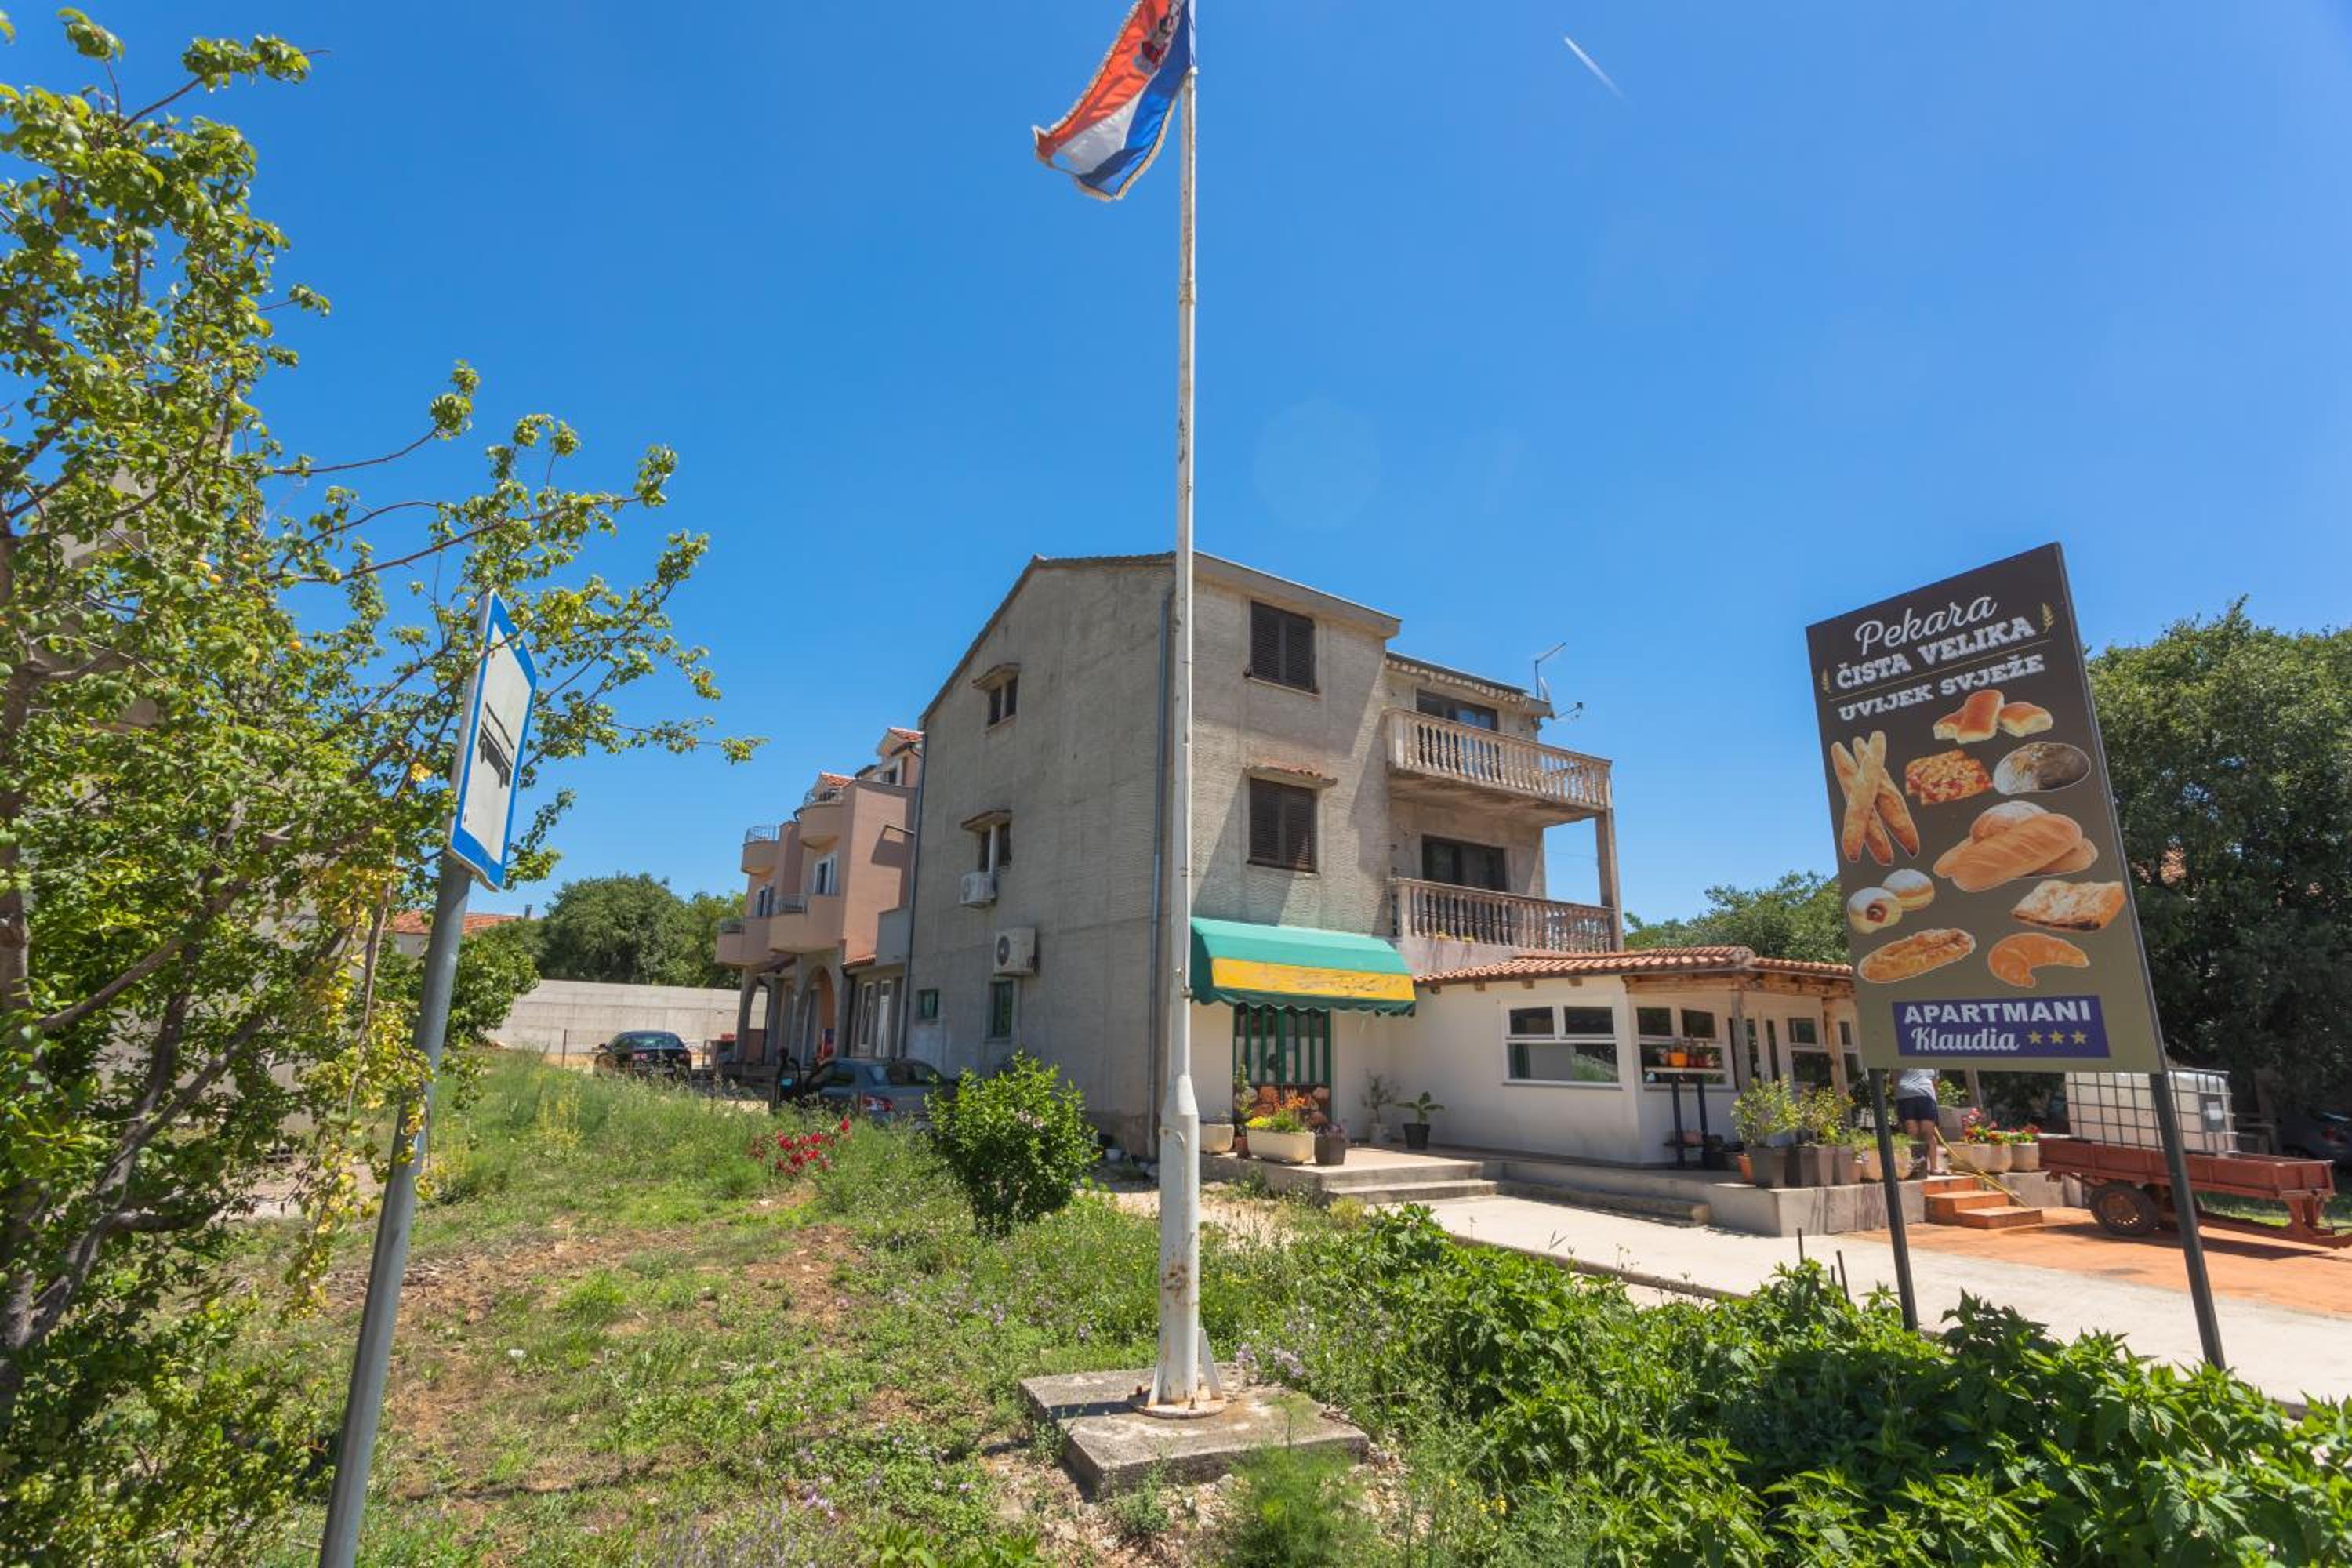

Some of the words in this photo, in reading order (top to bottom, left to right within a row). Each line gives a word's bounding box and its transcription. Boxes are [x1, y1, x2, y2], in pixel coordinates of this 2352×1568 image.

[1837, 653, 1911, 689] ČISTA
[1918, 617, 2036, 665] VELIKA
[1855, 597, 1998, 655] Pekara
[1839, 685, 1933, 720] UVIJEK
[1940, 655, 2045, 695] SVJEŽE
[1904, 1001, 2091, 1024] APARTMANI
[1911, 1026, 2020, 1051] Klaudia
